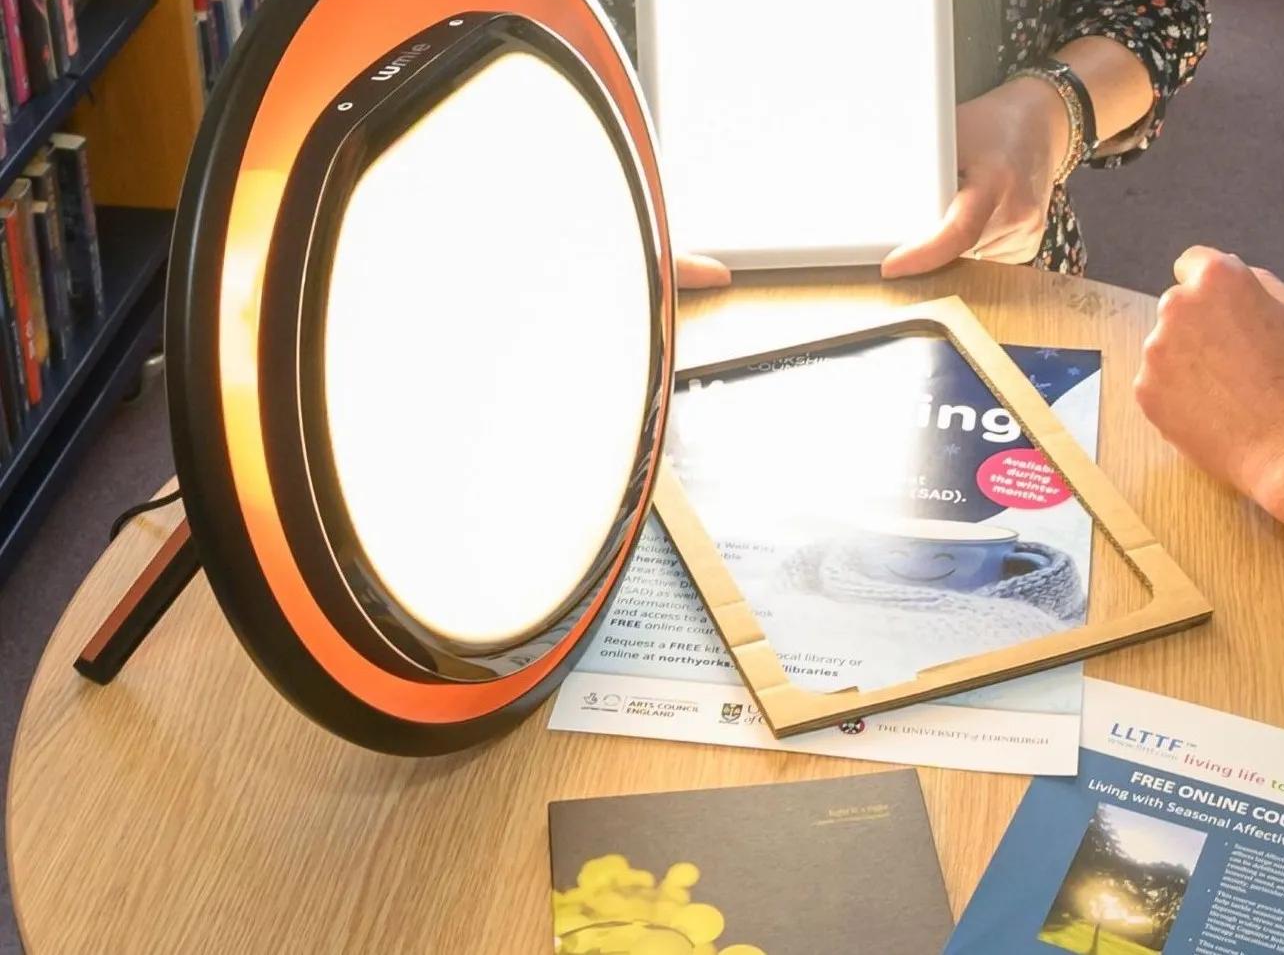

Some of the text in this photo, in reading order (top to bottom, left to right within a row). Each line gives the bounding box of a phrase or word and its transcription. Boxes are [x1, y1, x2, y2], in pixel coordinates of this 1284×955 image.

[1006, 468, 1051, 484] during
[990, 474, 1060, 495] the winter
[912, 489, 967, 504] (SAD).
[992, 485, 1047, 503] months.
[613, 607, 637, 617] and
[640, 611, 681, 622] access
[684, 614, 696, 622] to
[610, 618, 642, 629] FREE
[644, 622, 684, 633] online
[603, 636, 655, 648] Request
[669, 641, 702, 653] FREE
[704, 644, 720, 654] kit
[600, 649, 640, 661] online
[642, 652, 656, 662] at
[804, 652, 845, 666] library
[849, 658, 864, 666] or
[626, 708, 675, 718] ENGLAND
[628, 700, 655, 710] ARTS
[658, 703, 699, 713] COUNCIL
[878, 724, 897, 733] THE
[902, 727, 969, 741] UNIVERSITY
[981, 734, 1050, 746] EDINBURGH
[1184, 753, 1233, 779] living
[1238, 767, 1266, 785] life
[1130, 771, 1176, 794] FREE
[1178, 785, 1249, 816] ONLINE
[1088, 779, 1129, 801] Living
[1132, 792, 1164, 810] with
[1166, 802, 1231, 828] Seasonal
